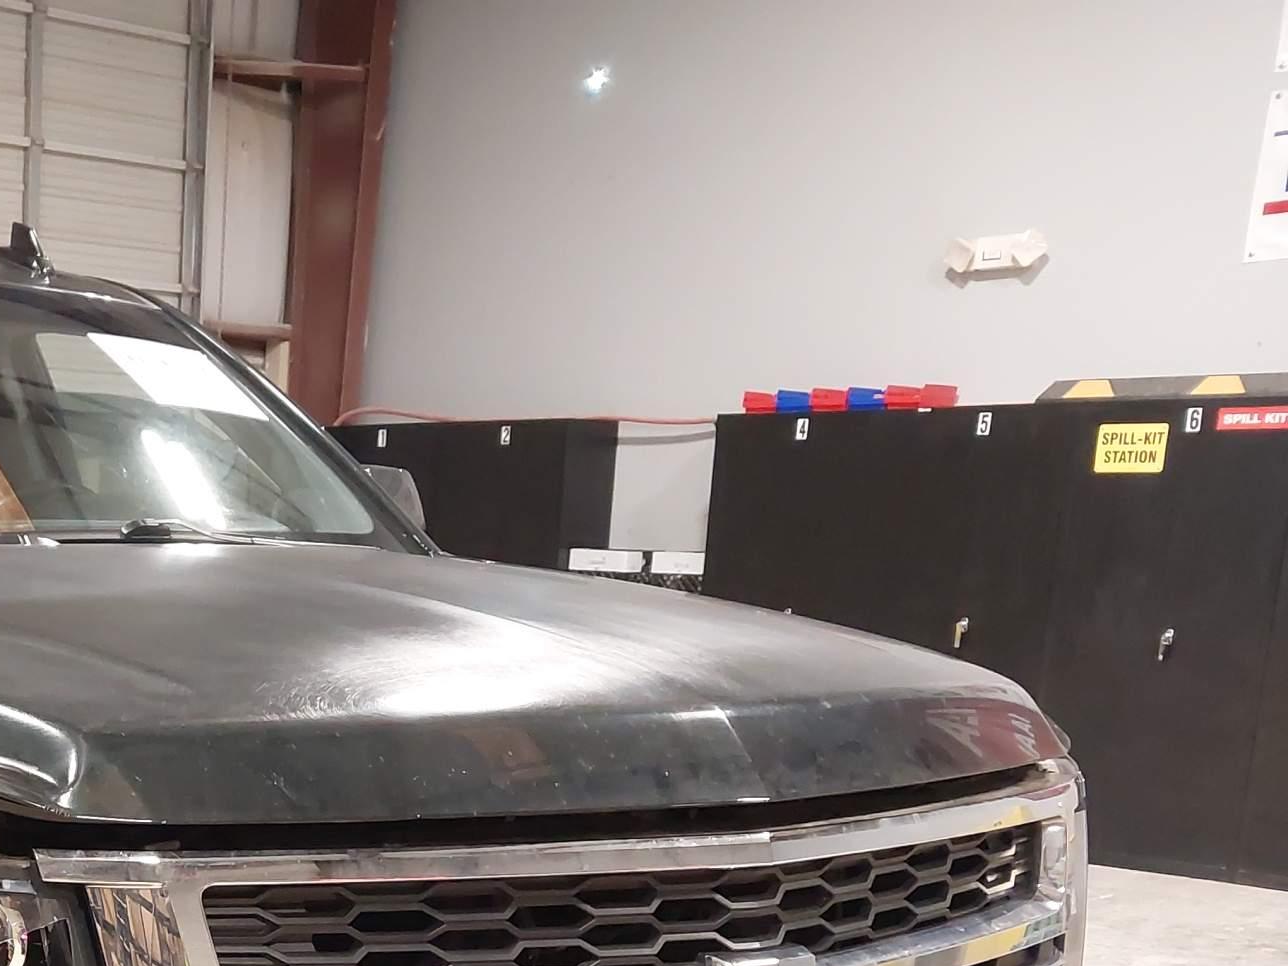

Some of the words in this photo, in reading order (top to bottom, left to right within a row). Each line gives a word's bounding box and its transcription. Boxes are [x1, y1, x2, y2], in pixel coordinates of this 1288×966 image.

[1189, 409, 1200, 430] 6
[1223, 413, 1261, 425] SPILL
[1101, 431, 1166, 446] SPILL-KIT
[1103, 450, 1158, 464] STATION
